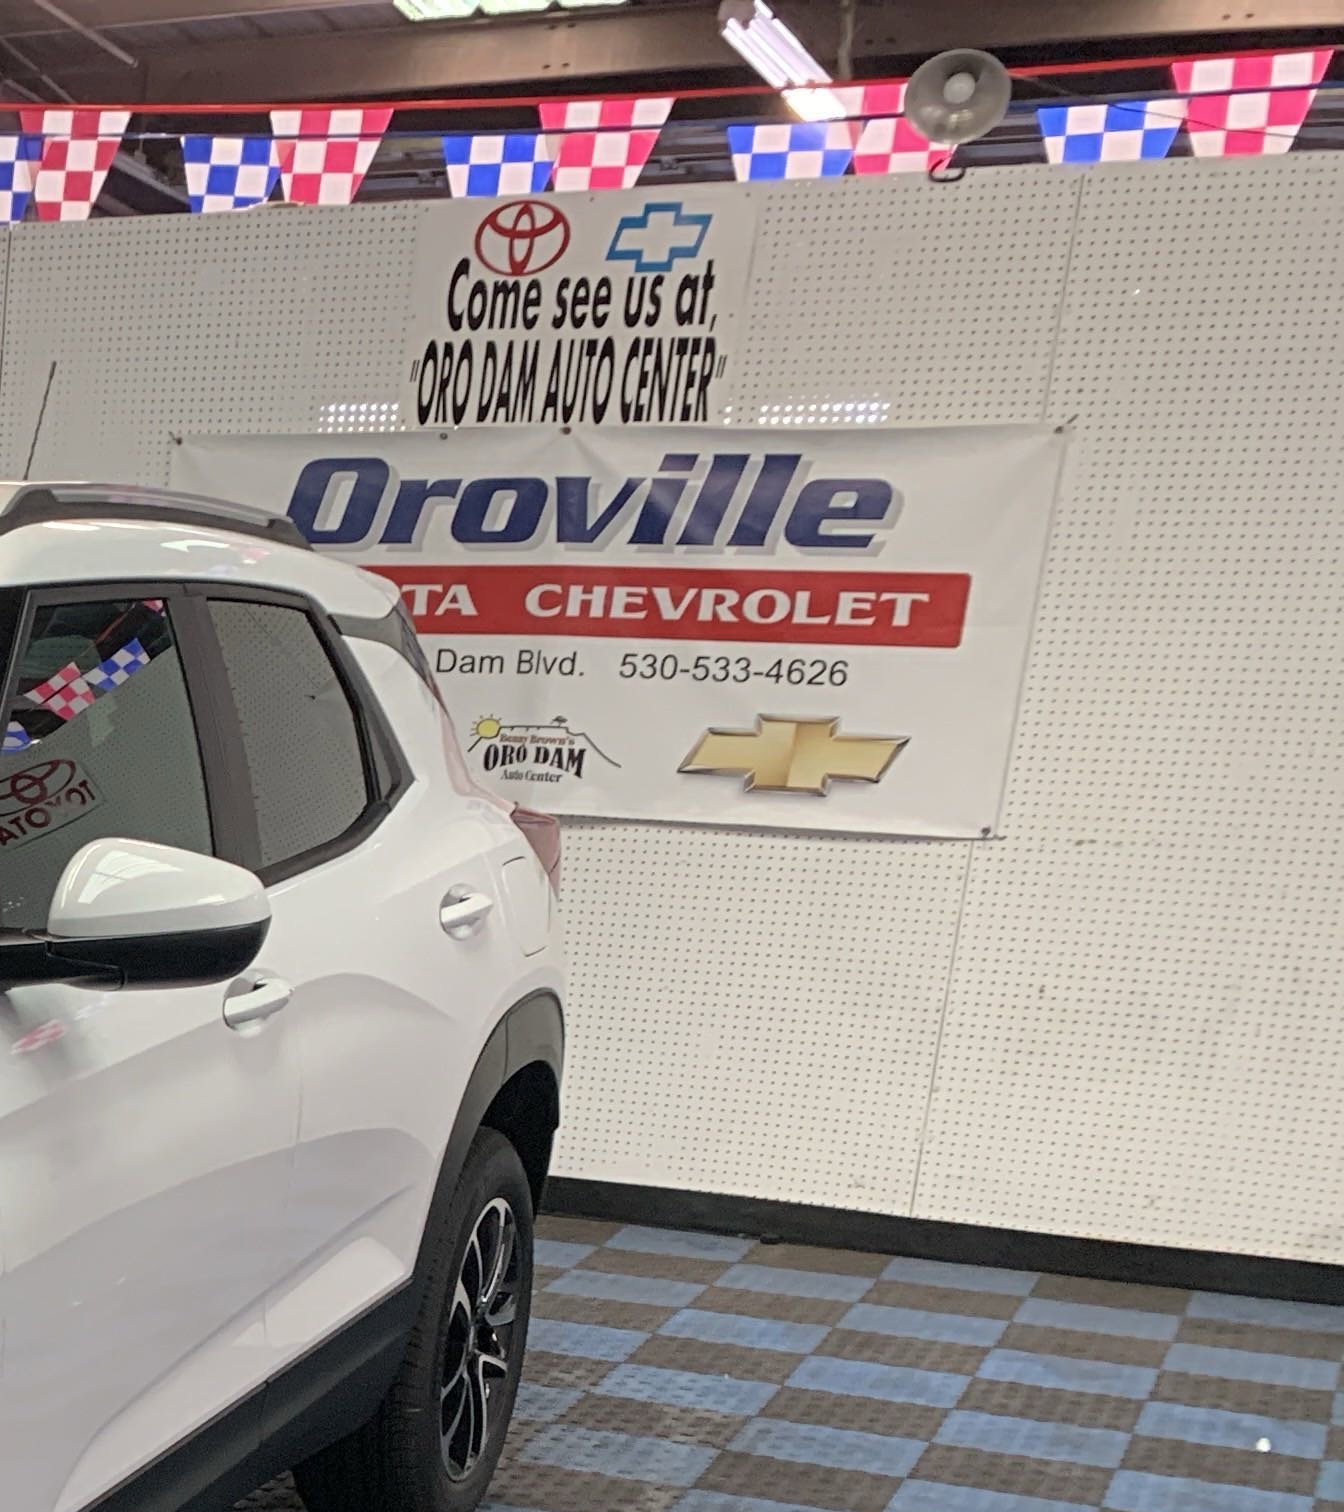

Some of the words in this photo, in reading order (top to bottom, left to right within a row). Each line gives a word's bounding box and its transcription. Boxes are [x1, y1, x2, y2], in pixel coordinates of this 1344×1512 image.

[447, 257, 542, 332] Come
[551, 275, 612, 329] see
[623, 273, 665, 328] us
[675, 258, 717, 333] at,
[410, 338, 473, 425] "ORO
[475, 339, 540, 423] DAM
[540, 336, 615, 424] AUTO
[620, 336, 727, 423] CENTER"
[288, 453, 893, 548] Oroville
[525, 583, 930, 627] CHEVROLET
[436, 648, 505, 674] Dam
[516, 649, 586, 676] Blvd.
[618, 652, 849, 687] 530-533-4626
[483, 743, 527, 771] ORO
[534, 746, 587, 778] DAM
[501, 769, 523, 781] Auto
[525, 771, 562, 783] Center
